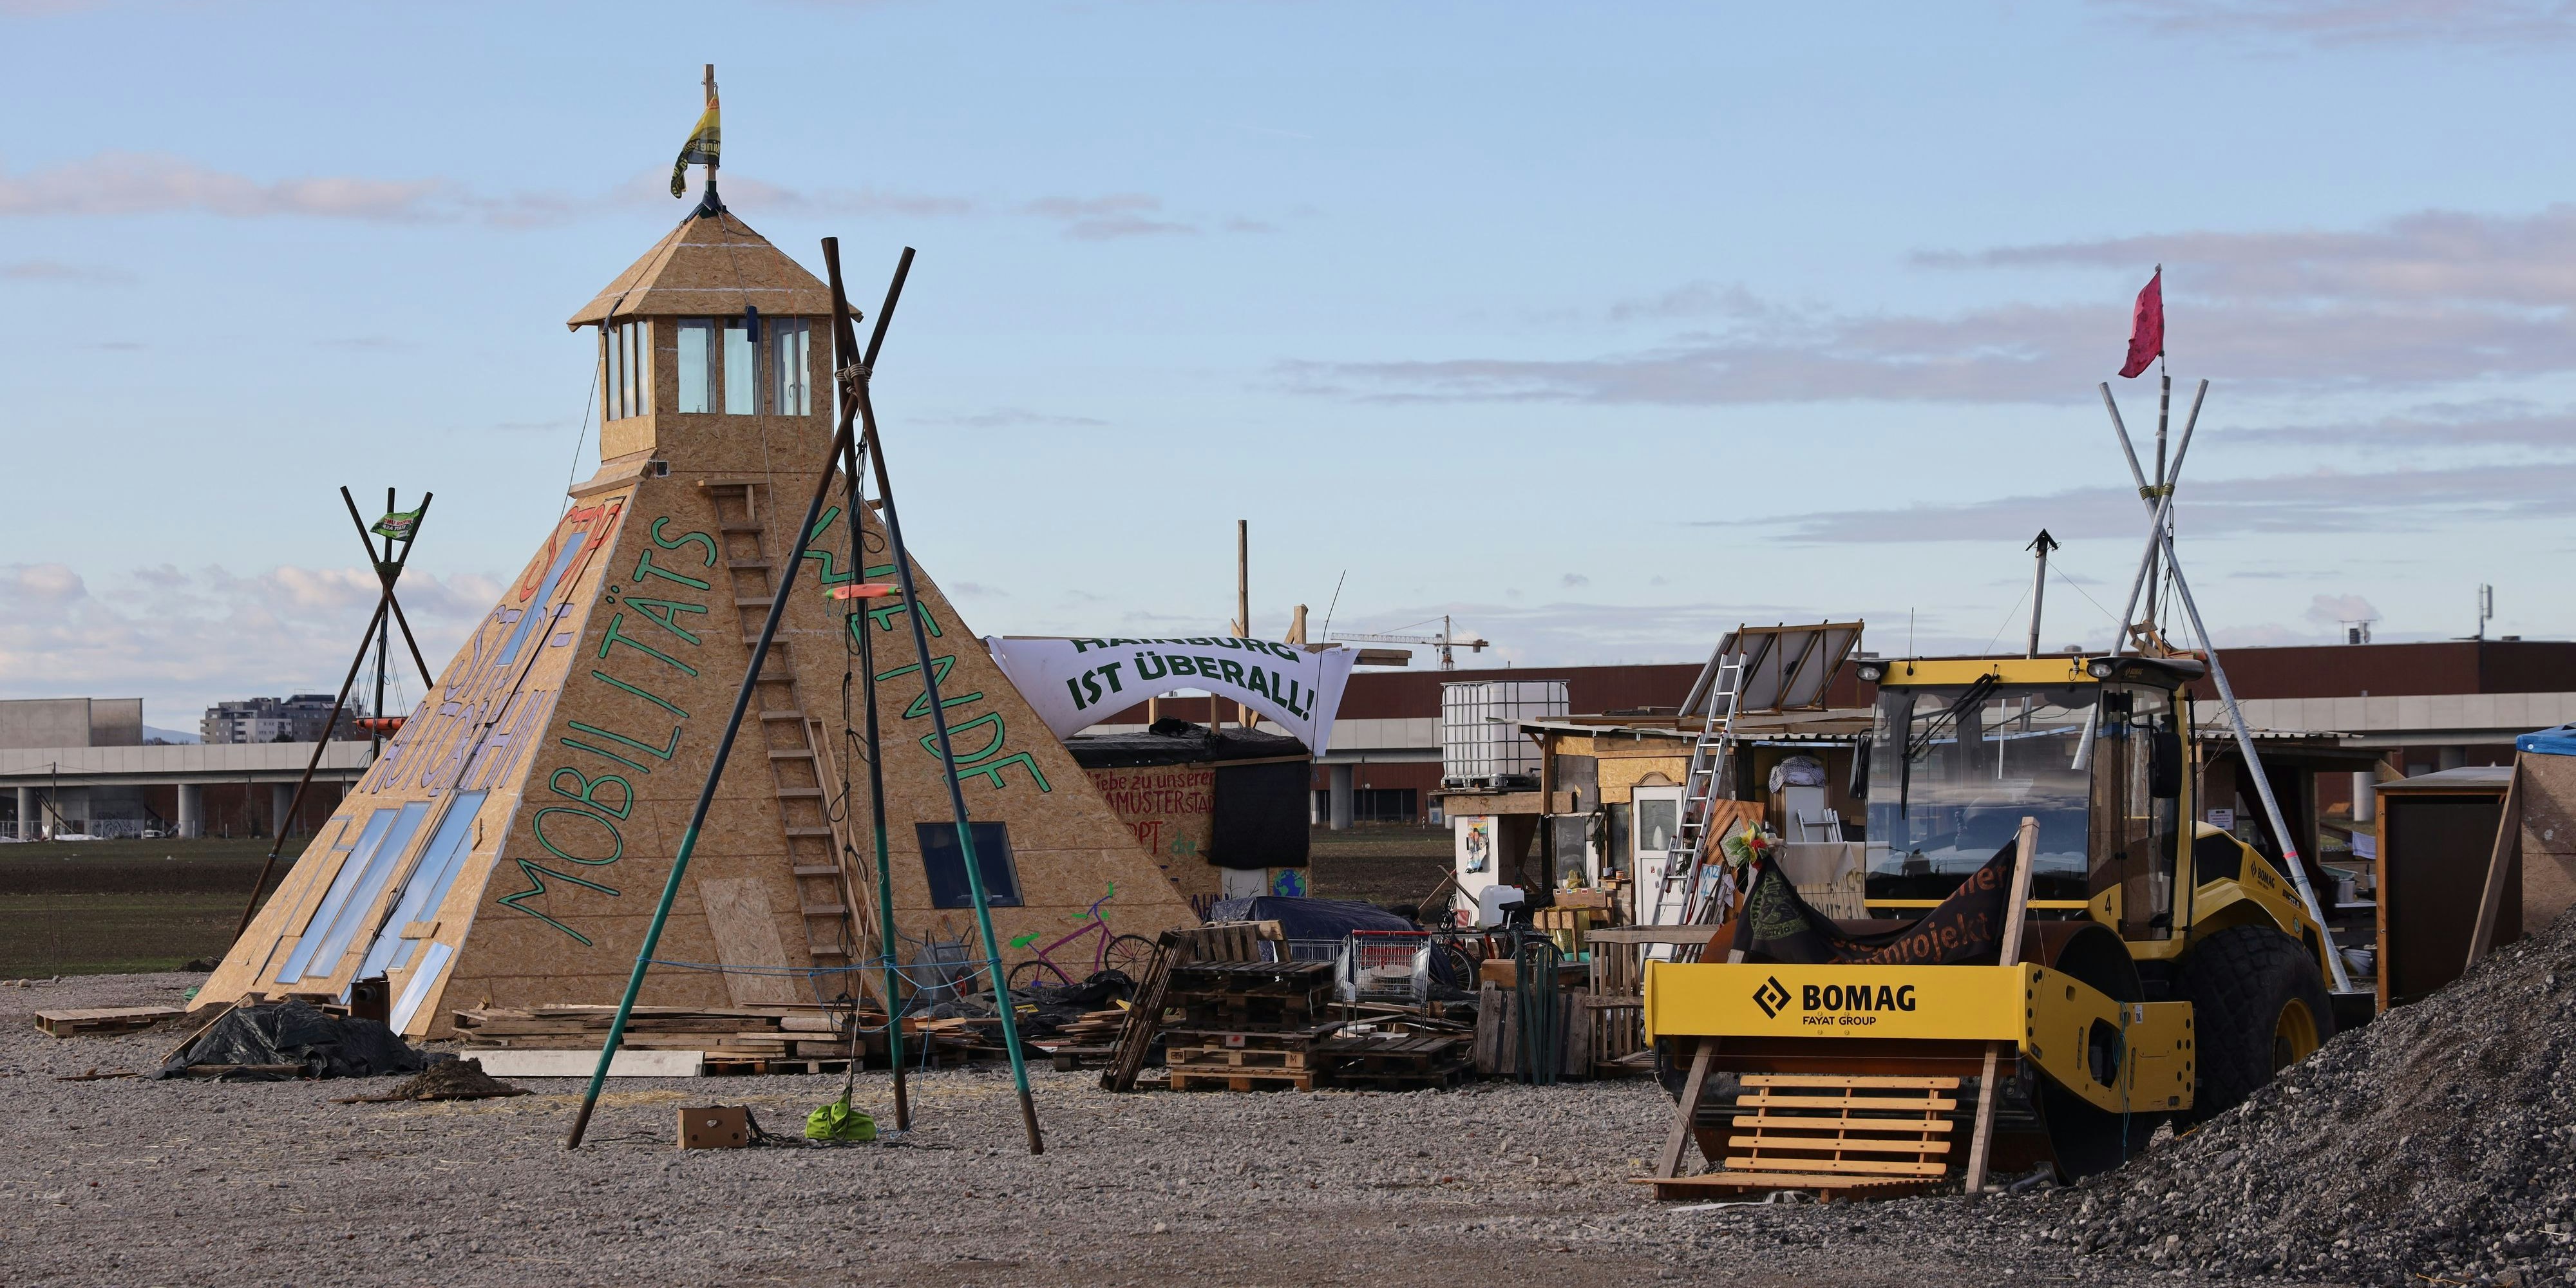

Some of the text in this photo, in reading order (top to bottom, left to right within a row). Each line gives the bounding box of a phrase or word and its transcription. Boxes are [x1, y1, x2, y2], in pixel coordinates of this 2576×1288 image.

[519, 504, 622, 603] STOP
[788, 506, 1052, 816] WENDE
[1066, 651, 1314, 721] IST ÜBERALL!
[360, 689, 558, 797] AUTOBAHN
[497, 516, 717, 947] MOBILITÄTS
[1087, 770, 1217, 791] iebe zu unserer
[2257, 867, 2275, 889] BOMAG
[2105, 893, 2112, 916] 4
[1803, 985, 1916, 1012] BOMAG
[1803, 1016, 1877, 1025] FAYAT GROUP
[1290, 1054, 1297, 1063] M
